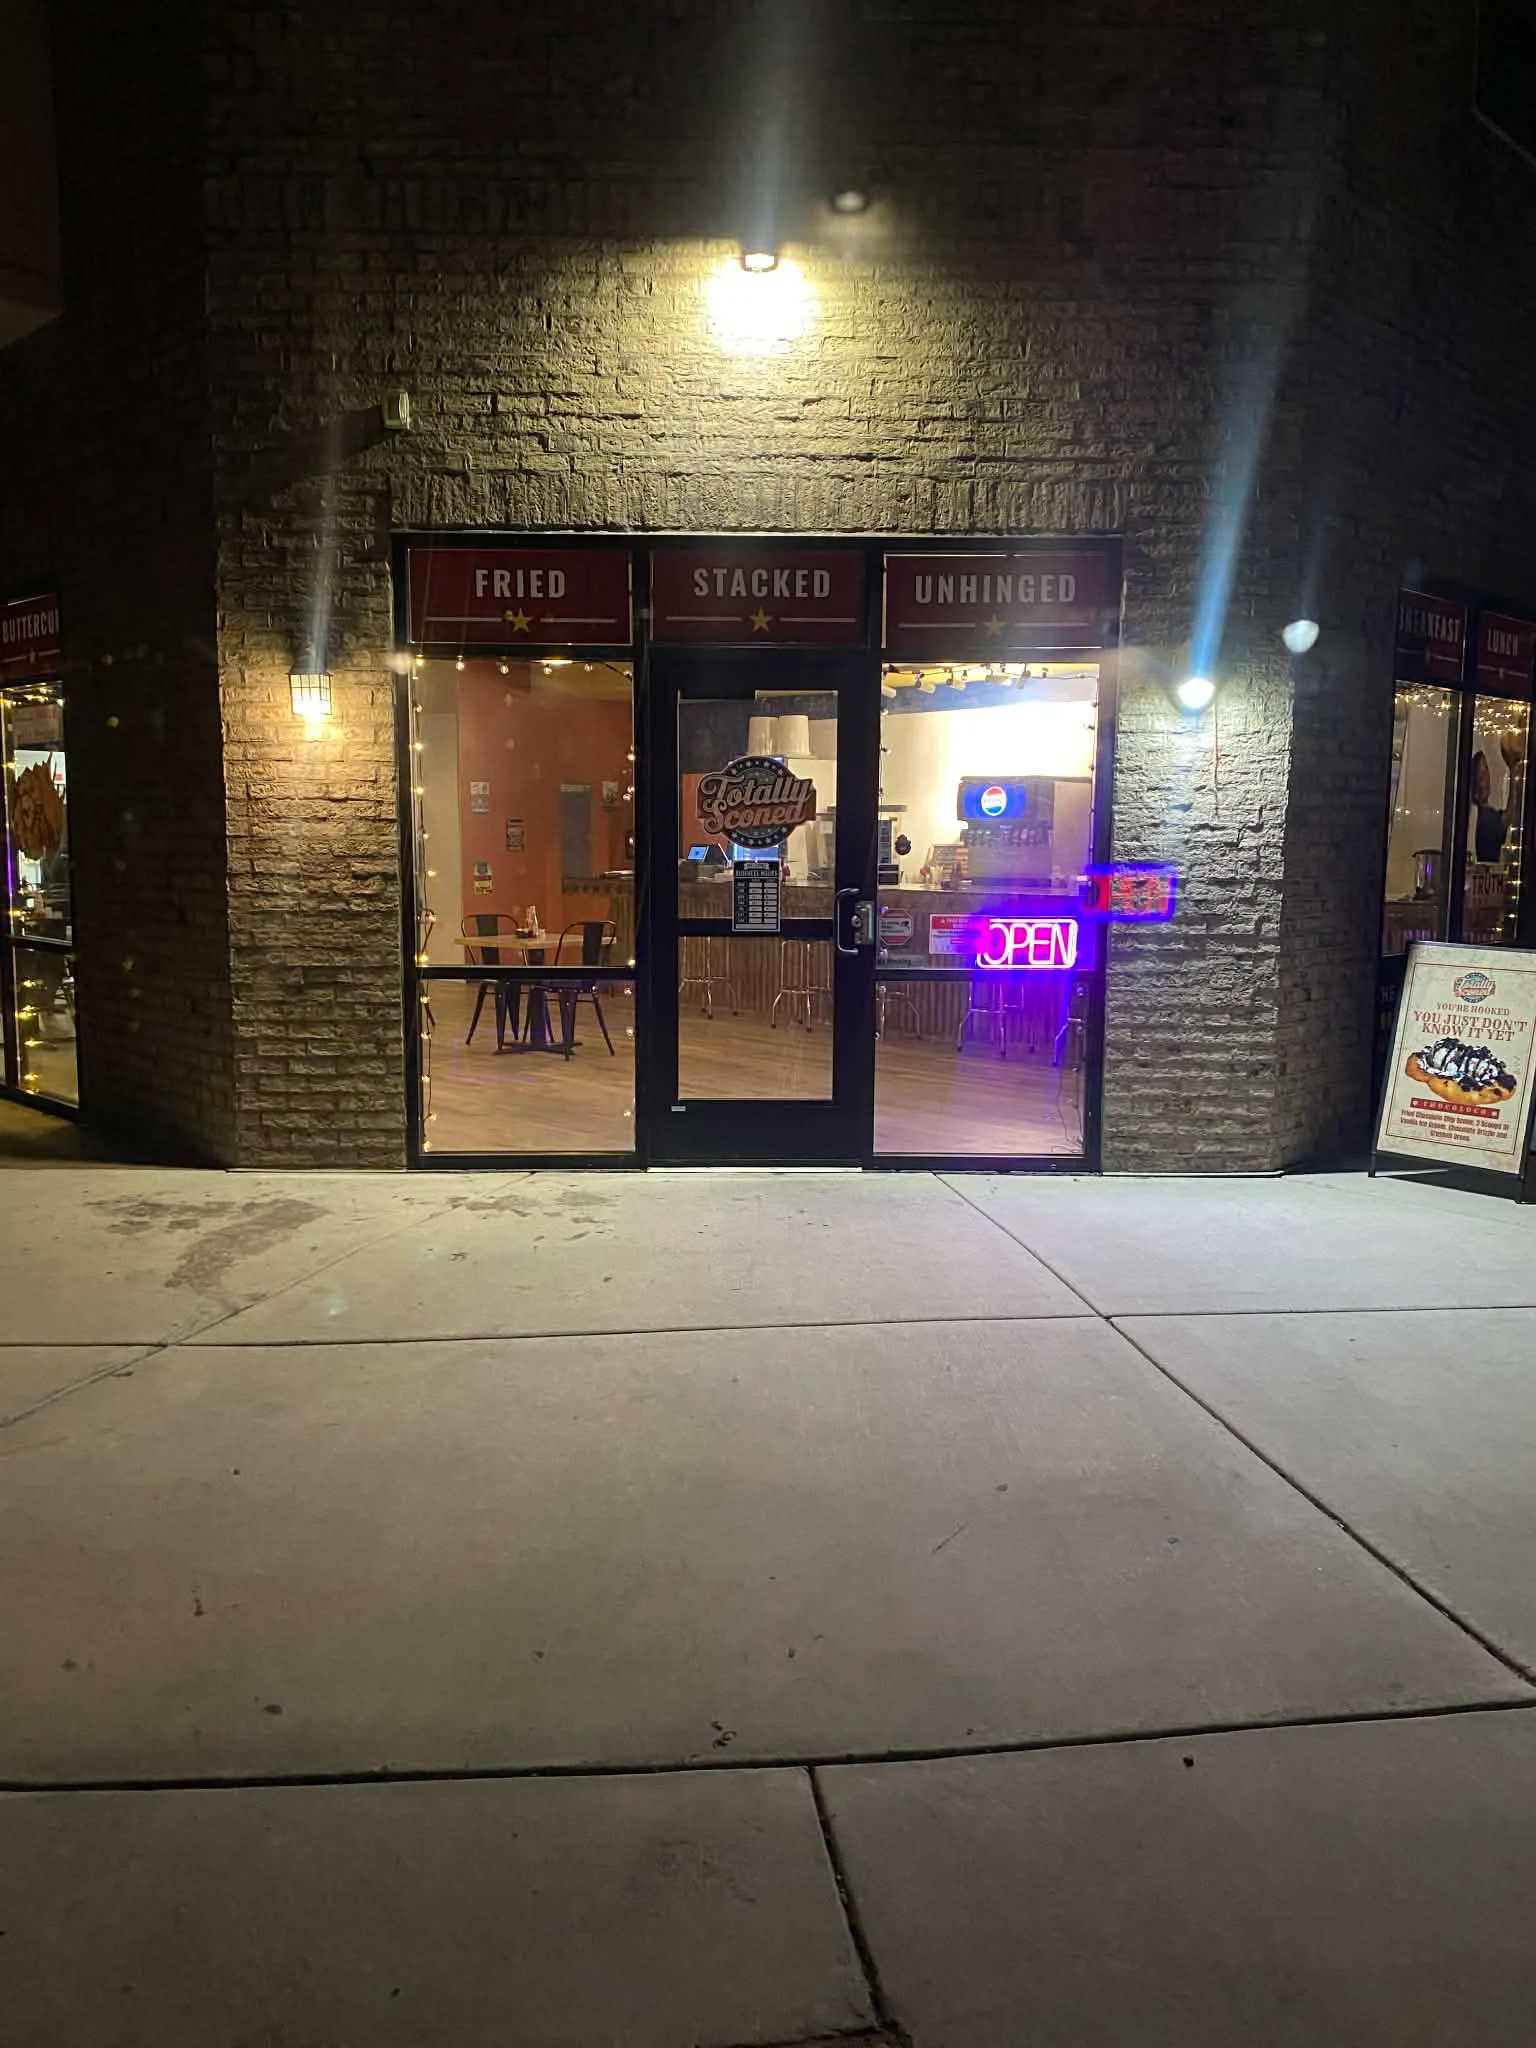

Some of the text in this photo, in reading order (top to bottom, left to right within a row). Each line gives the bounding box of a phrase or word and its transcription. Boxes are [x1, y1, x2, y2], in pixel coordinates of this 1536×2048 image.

[475, 569, 566, 598] FRIED
[693, 568, 831, 598] STACKED
[915, 574, 1076, 604] UNHINGED
[1487, 628, 1519, 656] LUNCH
[700, 773, 814, 810] Totally
[703, 797, 805, 834] Sconed
[1472, 873, 1504, 895] TRUTH
[984, 922, 1075, 965] OPEN
[1414, 1011, 1528, 1032] YOU JUST DON'T
[1437, 1002, 1510, 1016] YOU'RE HOOKED
[1422, 1023, 1515, 1042] KNOW IT YET
